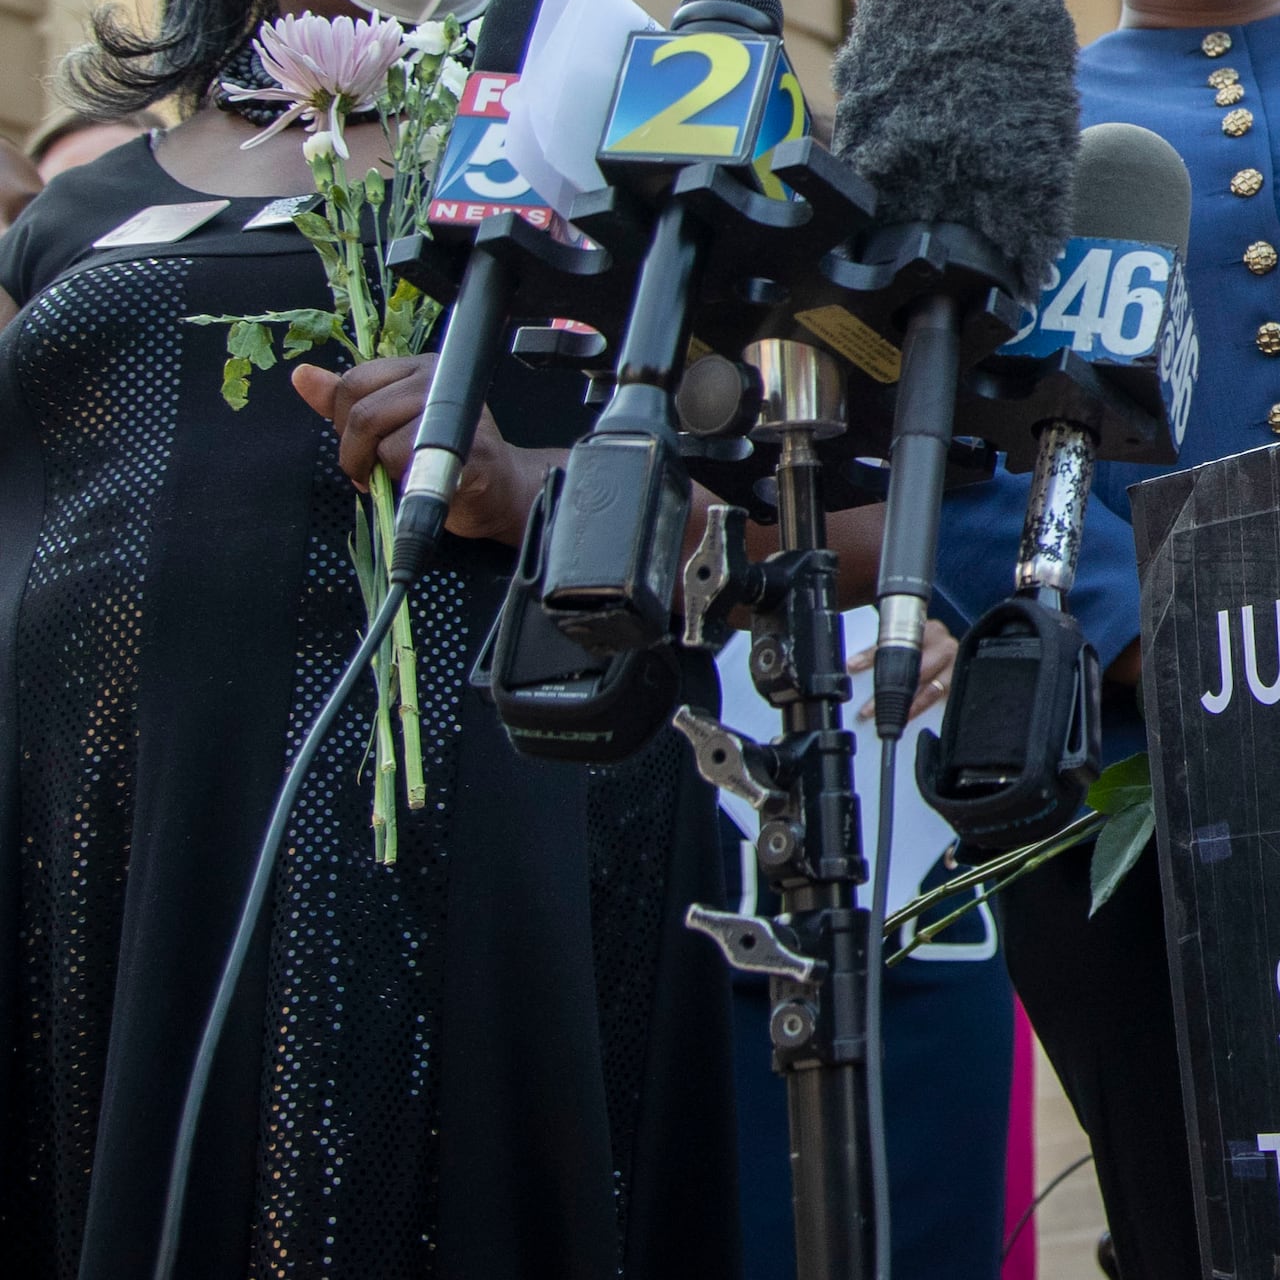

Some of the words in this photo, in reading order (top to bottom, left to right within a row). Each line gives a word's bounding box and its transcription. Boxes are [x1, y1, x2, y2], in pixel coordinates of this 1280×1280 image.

[604, 33, 751, 156] 2
[464, 122, 533, 199] 5
[1041, 247, 1169, 357] 46
